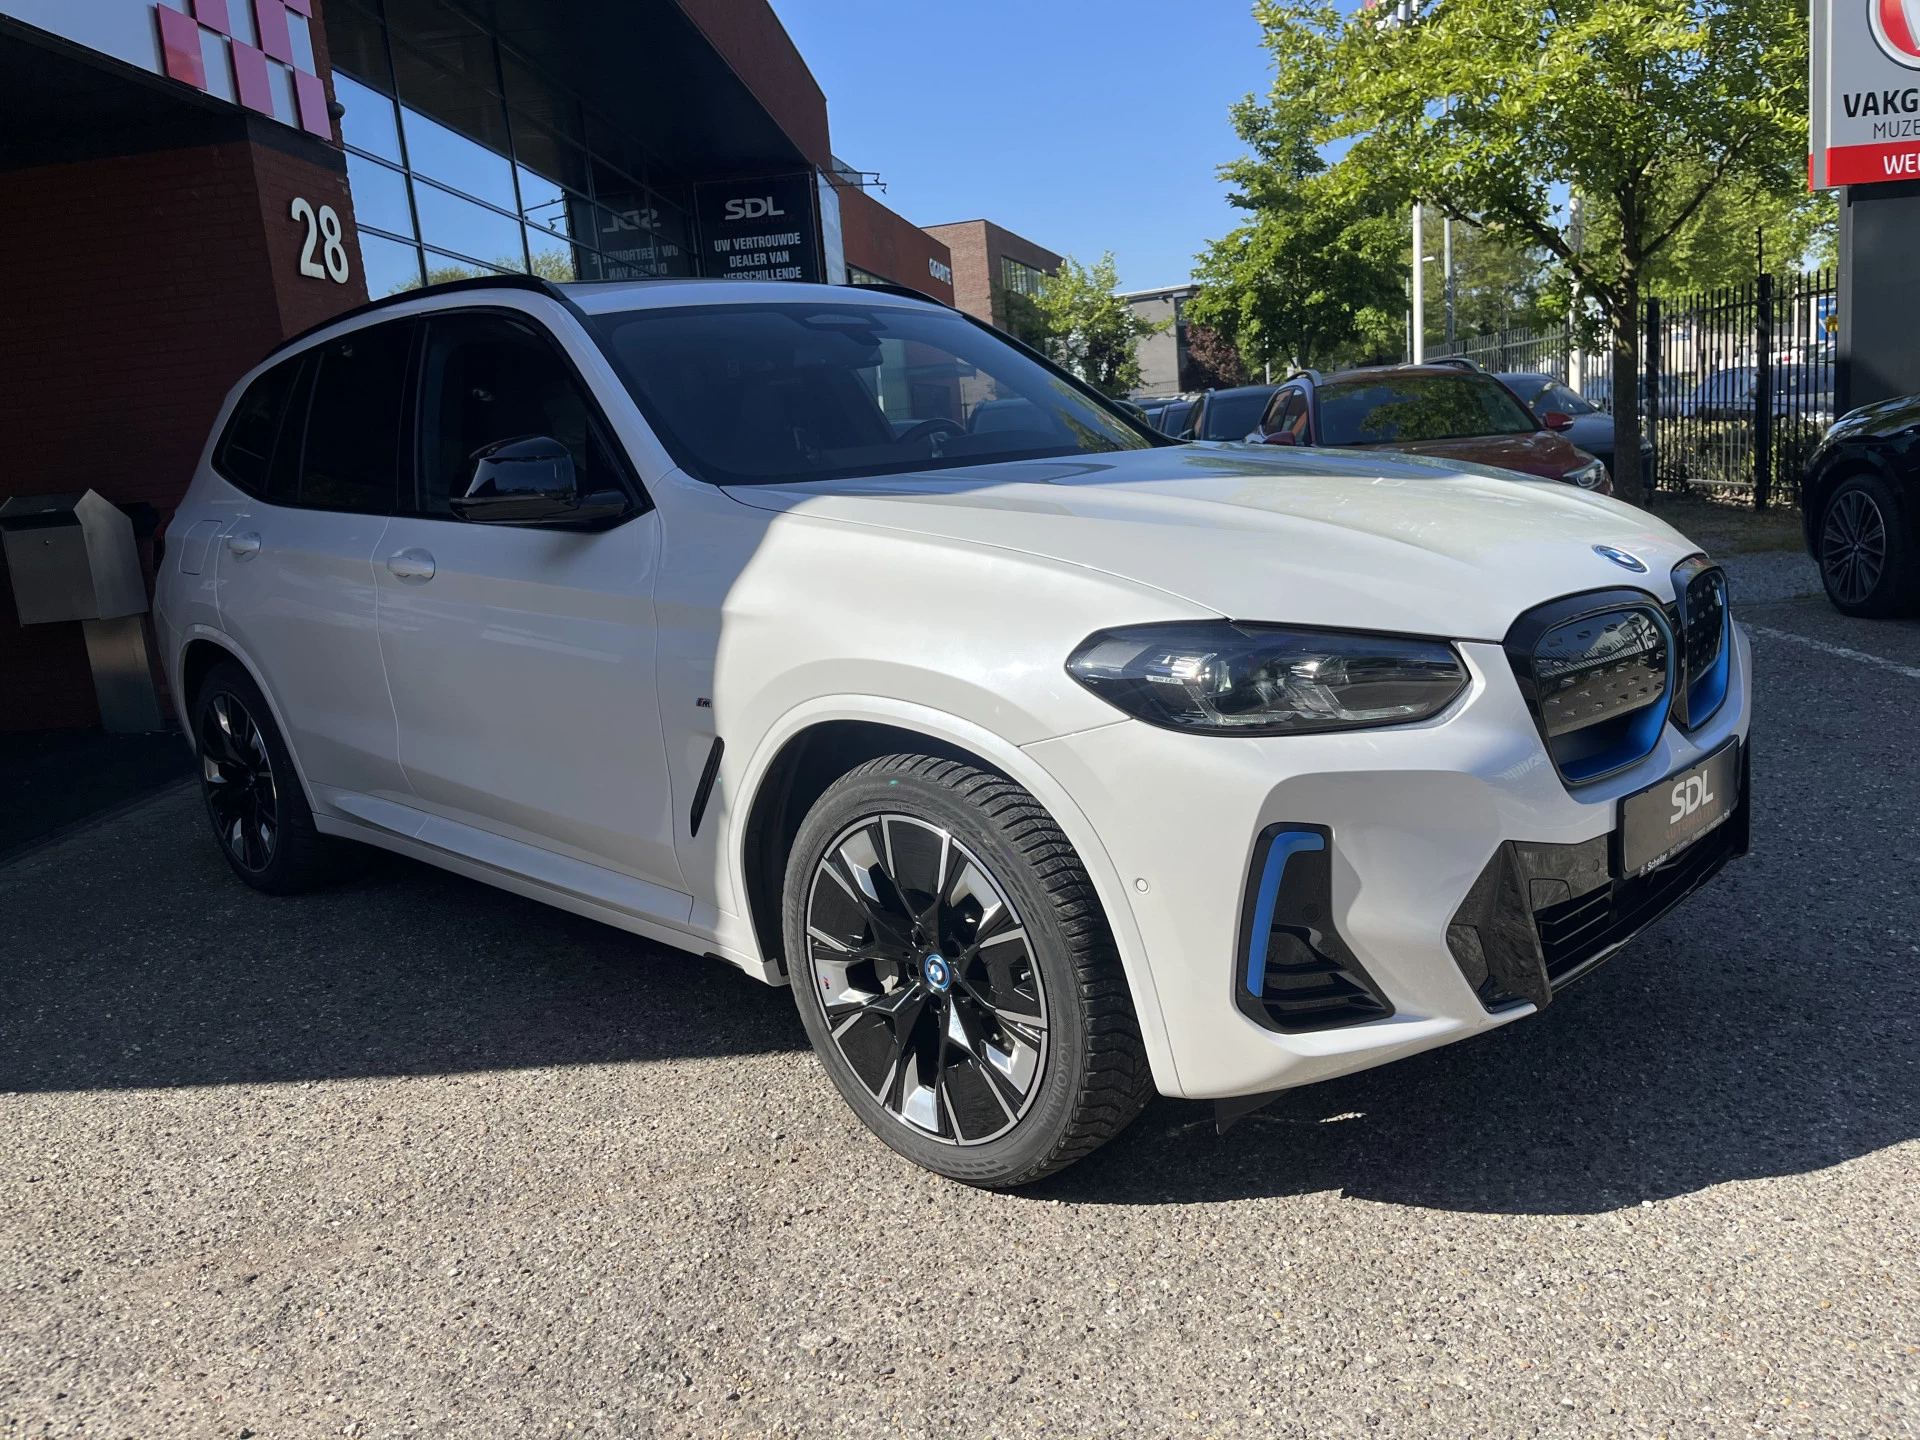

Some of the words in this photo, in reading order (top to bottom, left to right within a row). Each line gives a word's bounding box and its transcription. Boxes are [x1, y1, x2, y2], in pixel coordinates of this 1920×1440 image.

[1843, 88, 1919, 118] VAKG
[1873, 119, 1920, 139] MUZE
[1883, 153, 1920, 175] WE
[724, 196, 785, 221] SDL
[291, 197, 349, 284] 28
[714, 239, 731, 252] UW
[732, 232, 801, 250] VERTROUWDE
[729, 252, 767, 268] DEALER
[768, 250, 790, 264] VAN
[1669, 769, 1714, 825] SDL
[1038, 1042, 1071, 1131] YOKOHAMA
